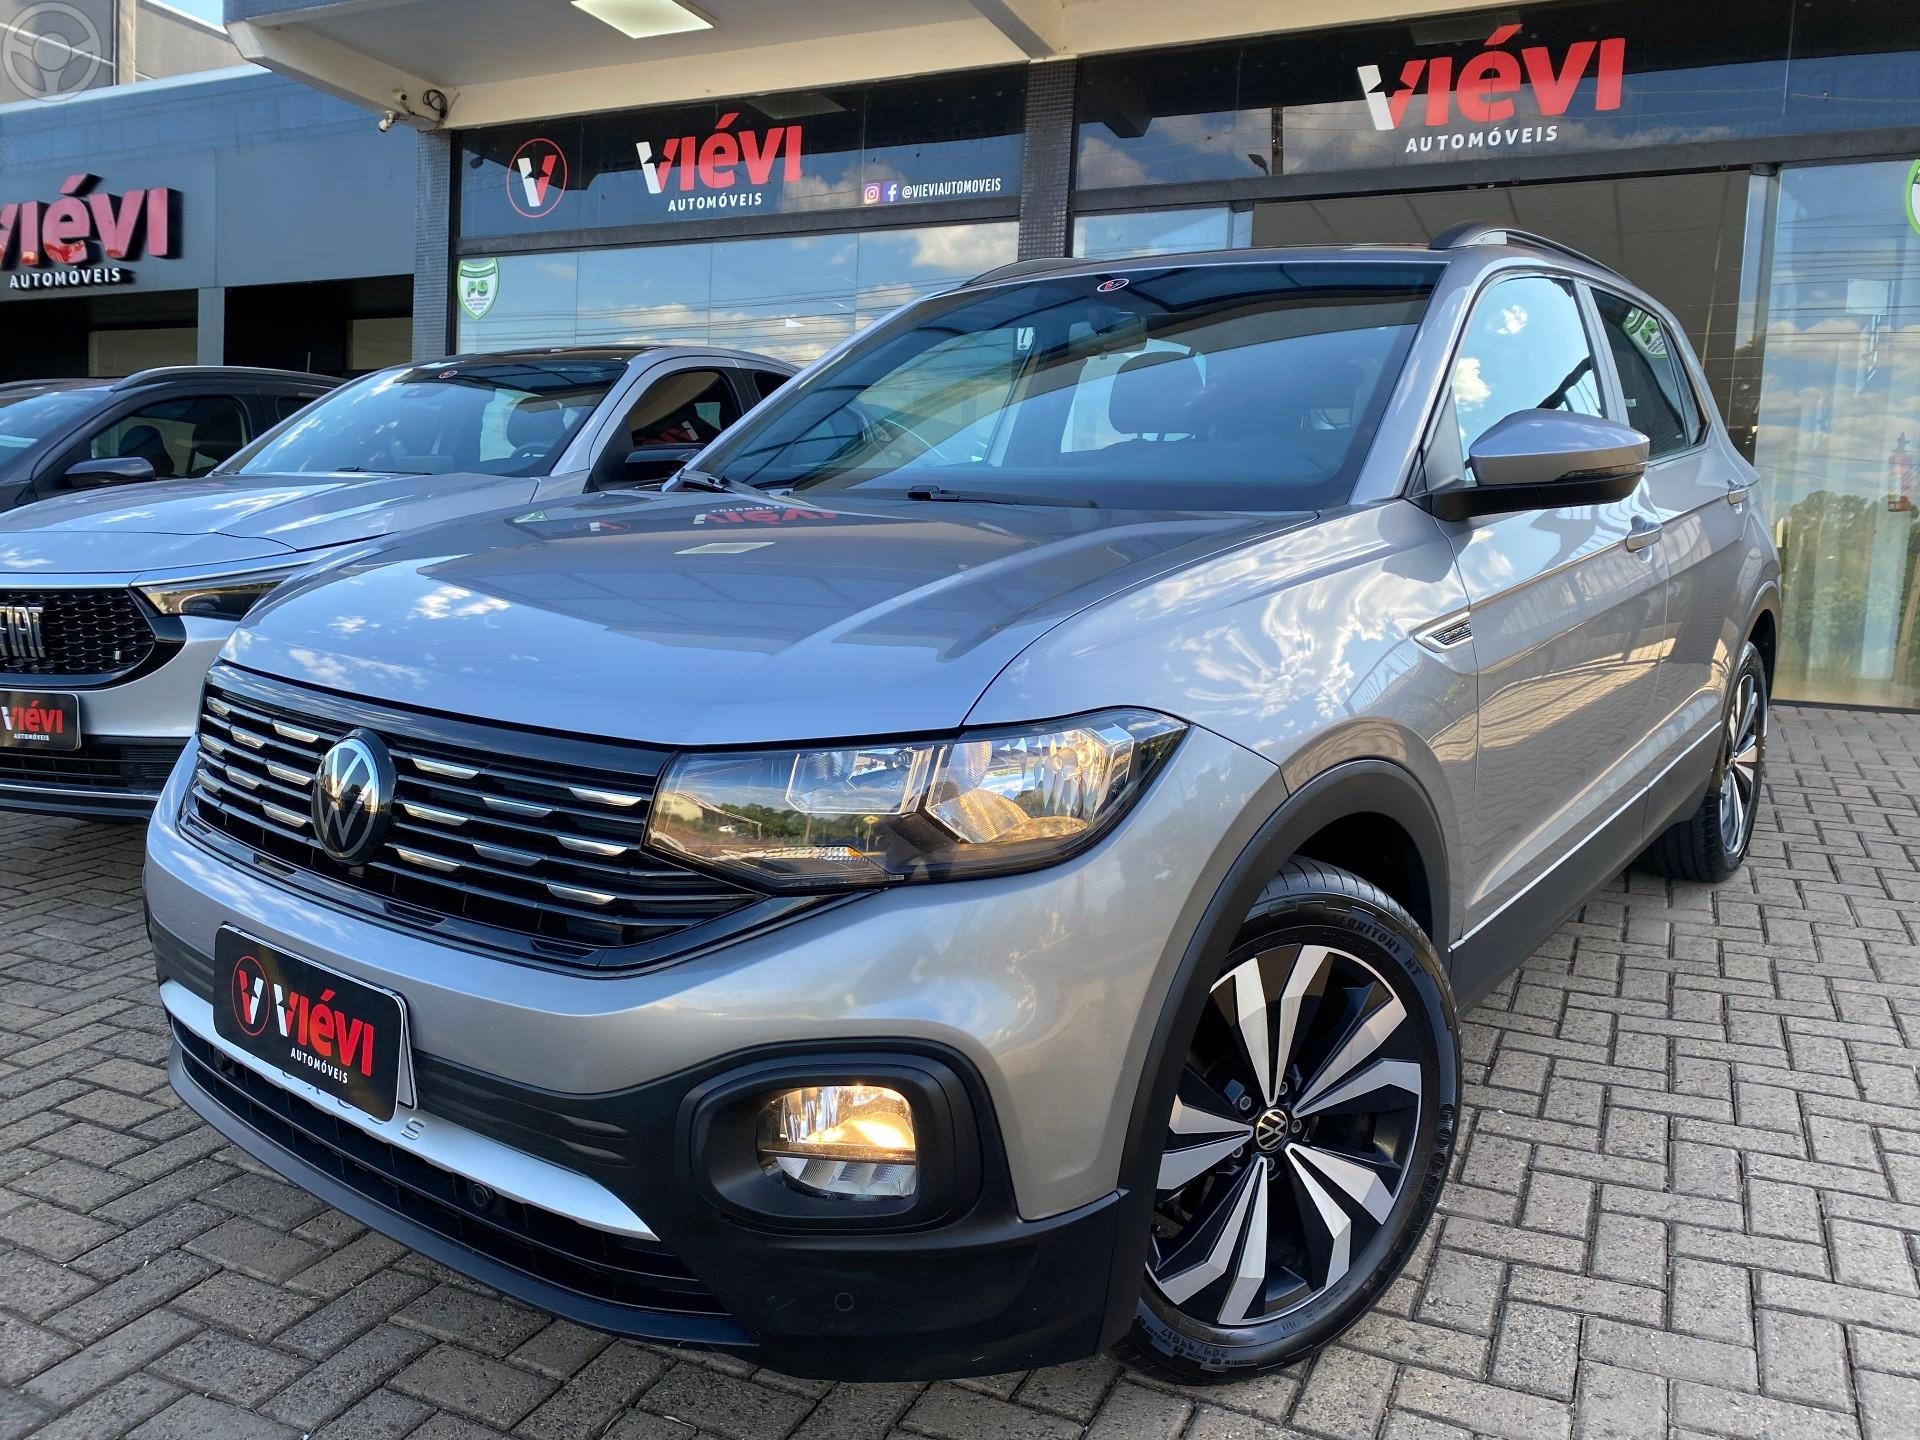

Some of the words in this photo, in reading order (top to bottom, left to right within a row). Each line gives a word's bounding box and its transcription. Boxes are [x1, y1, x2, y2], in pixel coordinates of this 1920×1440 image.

[1405, 125, 1559, 153] AUTOMÓVEIS
[902, 177, 1002, 199] @VIEVIAUTOMOVEIS
[668, 192, 762, 212] AUTOMÓVEIS
[9, 265, 121, 289] AUTOMÓVEIS
[13, 733, 50, 741] AUTOMÓVEIS
[1335, 914, 1403, 954] ERRITORY
[290, 1047, 348, 1084] AUTOMÓVEIS
